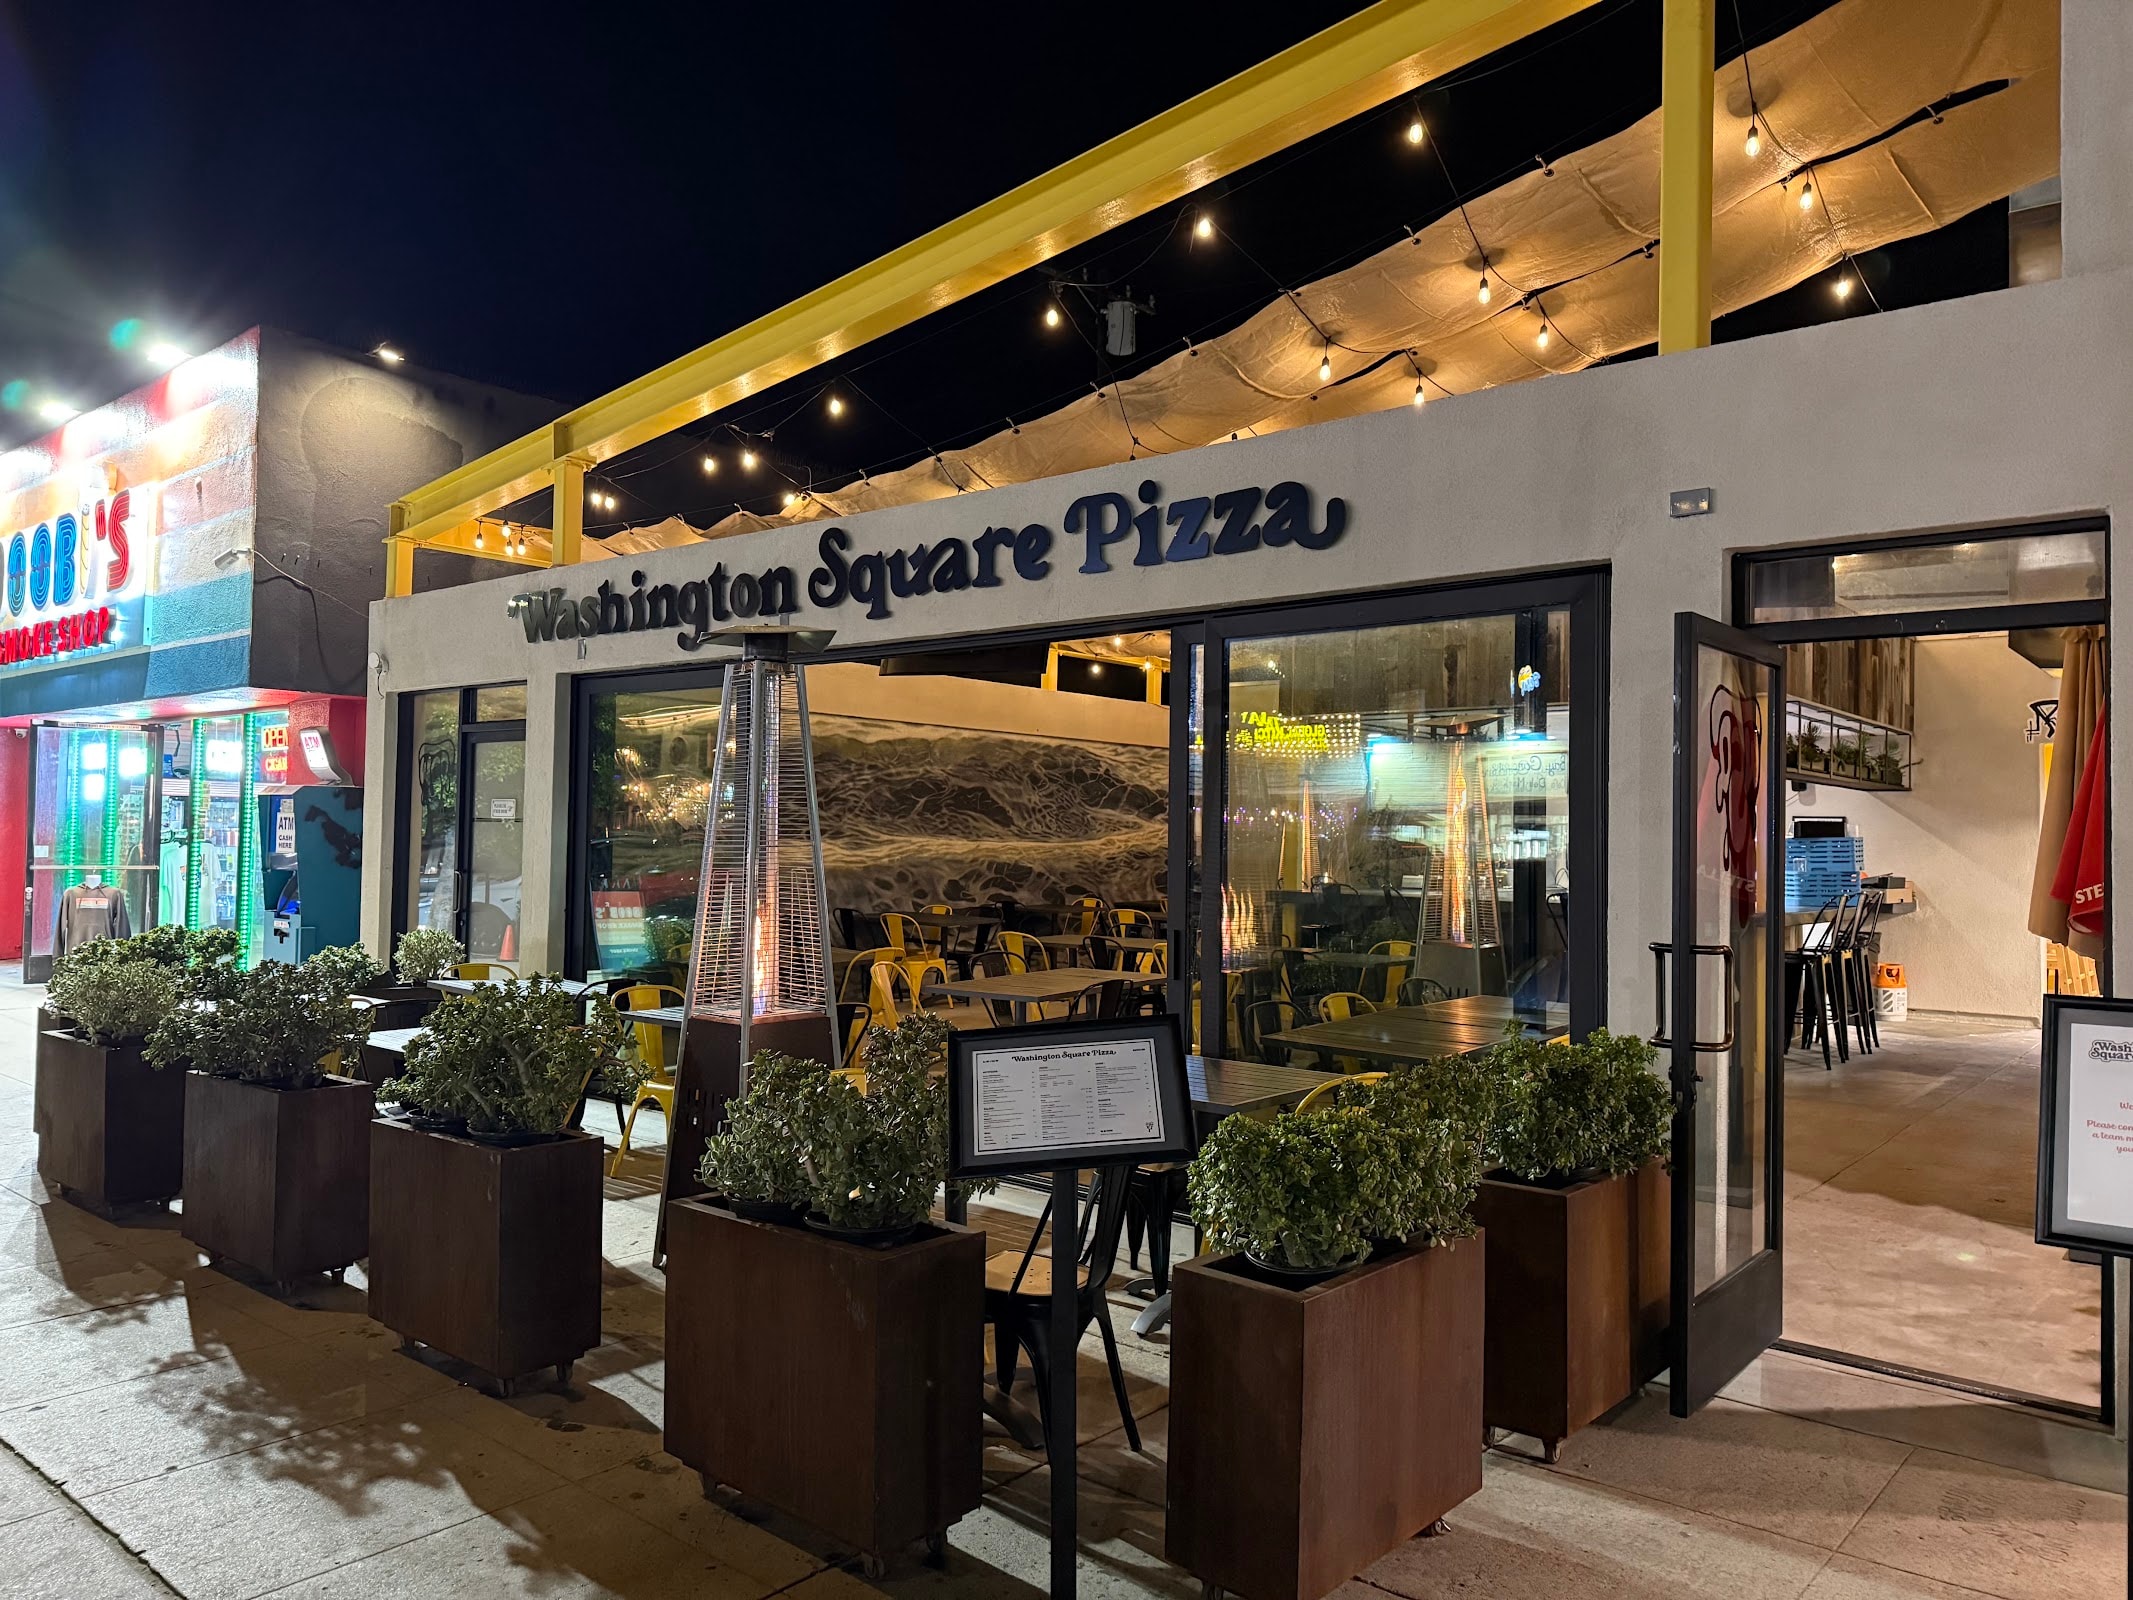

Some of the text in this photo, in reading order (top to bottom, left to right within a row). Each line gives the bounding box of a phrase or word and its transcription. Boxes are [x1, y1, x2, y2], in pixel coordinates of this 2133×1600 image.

[507, 480, 1346, 651] Washington Square Pizza
[57, 607, 109, 651] SHOP
[304, 737, 320, 749] ATM
[278, 817, 294, 830] ATM
[2075, 883, 2104, 904] STE
[1011, 1049, 1117, 1062] Washington Square Pizza
[2090, 1047, 2133, 1060] Squar
[2087, 1119, 2117, 1130] Please
[2101, 1131, 2125, 1141] team
